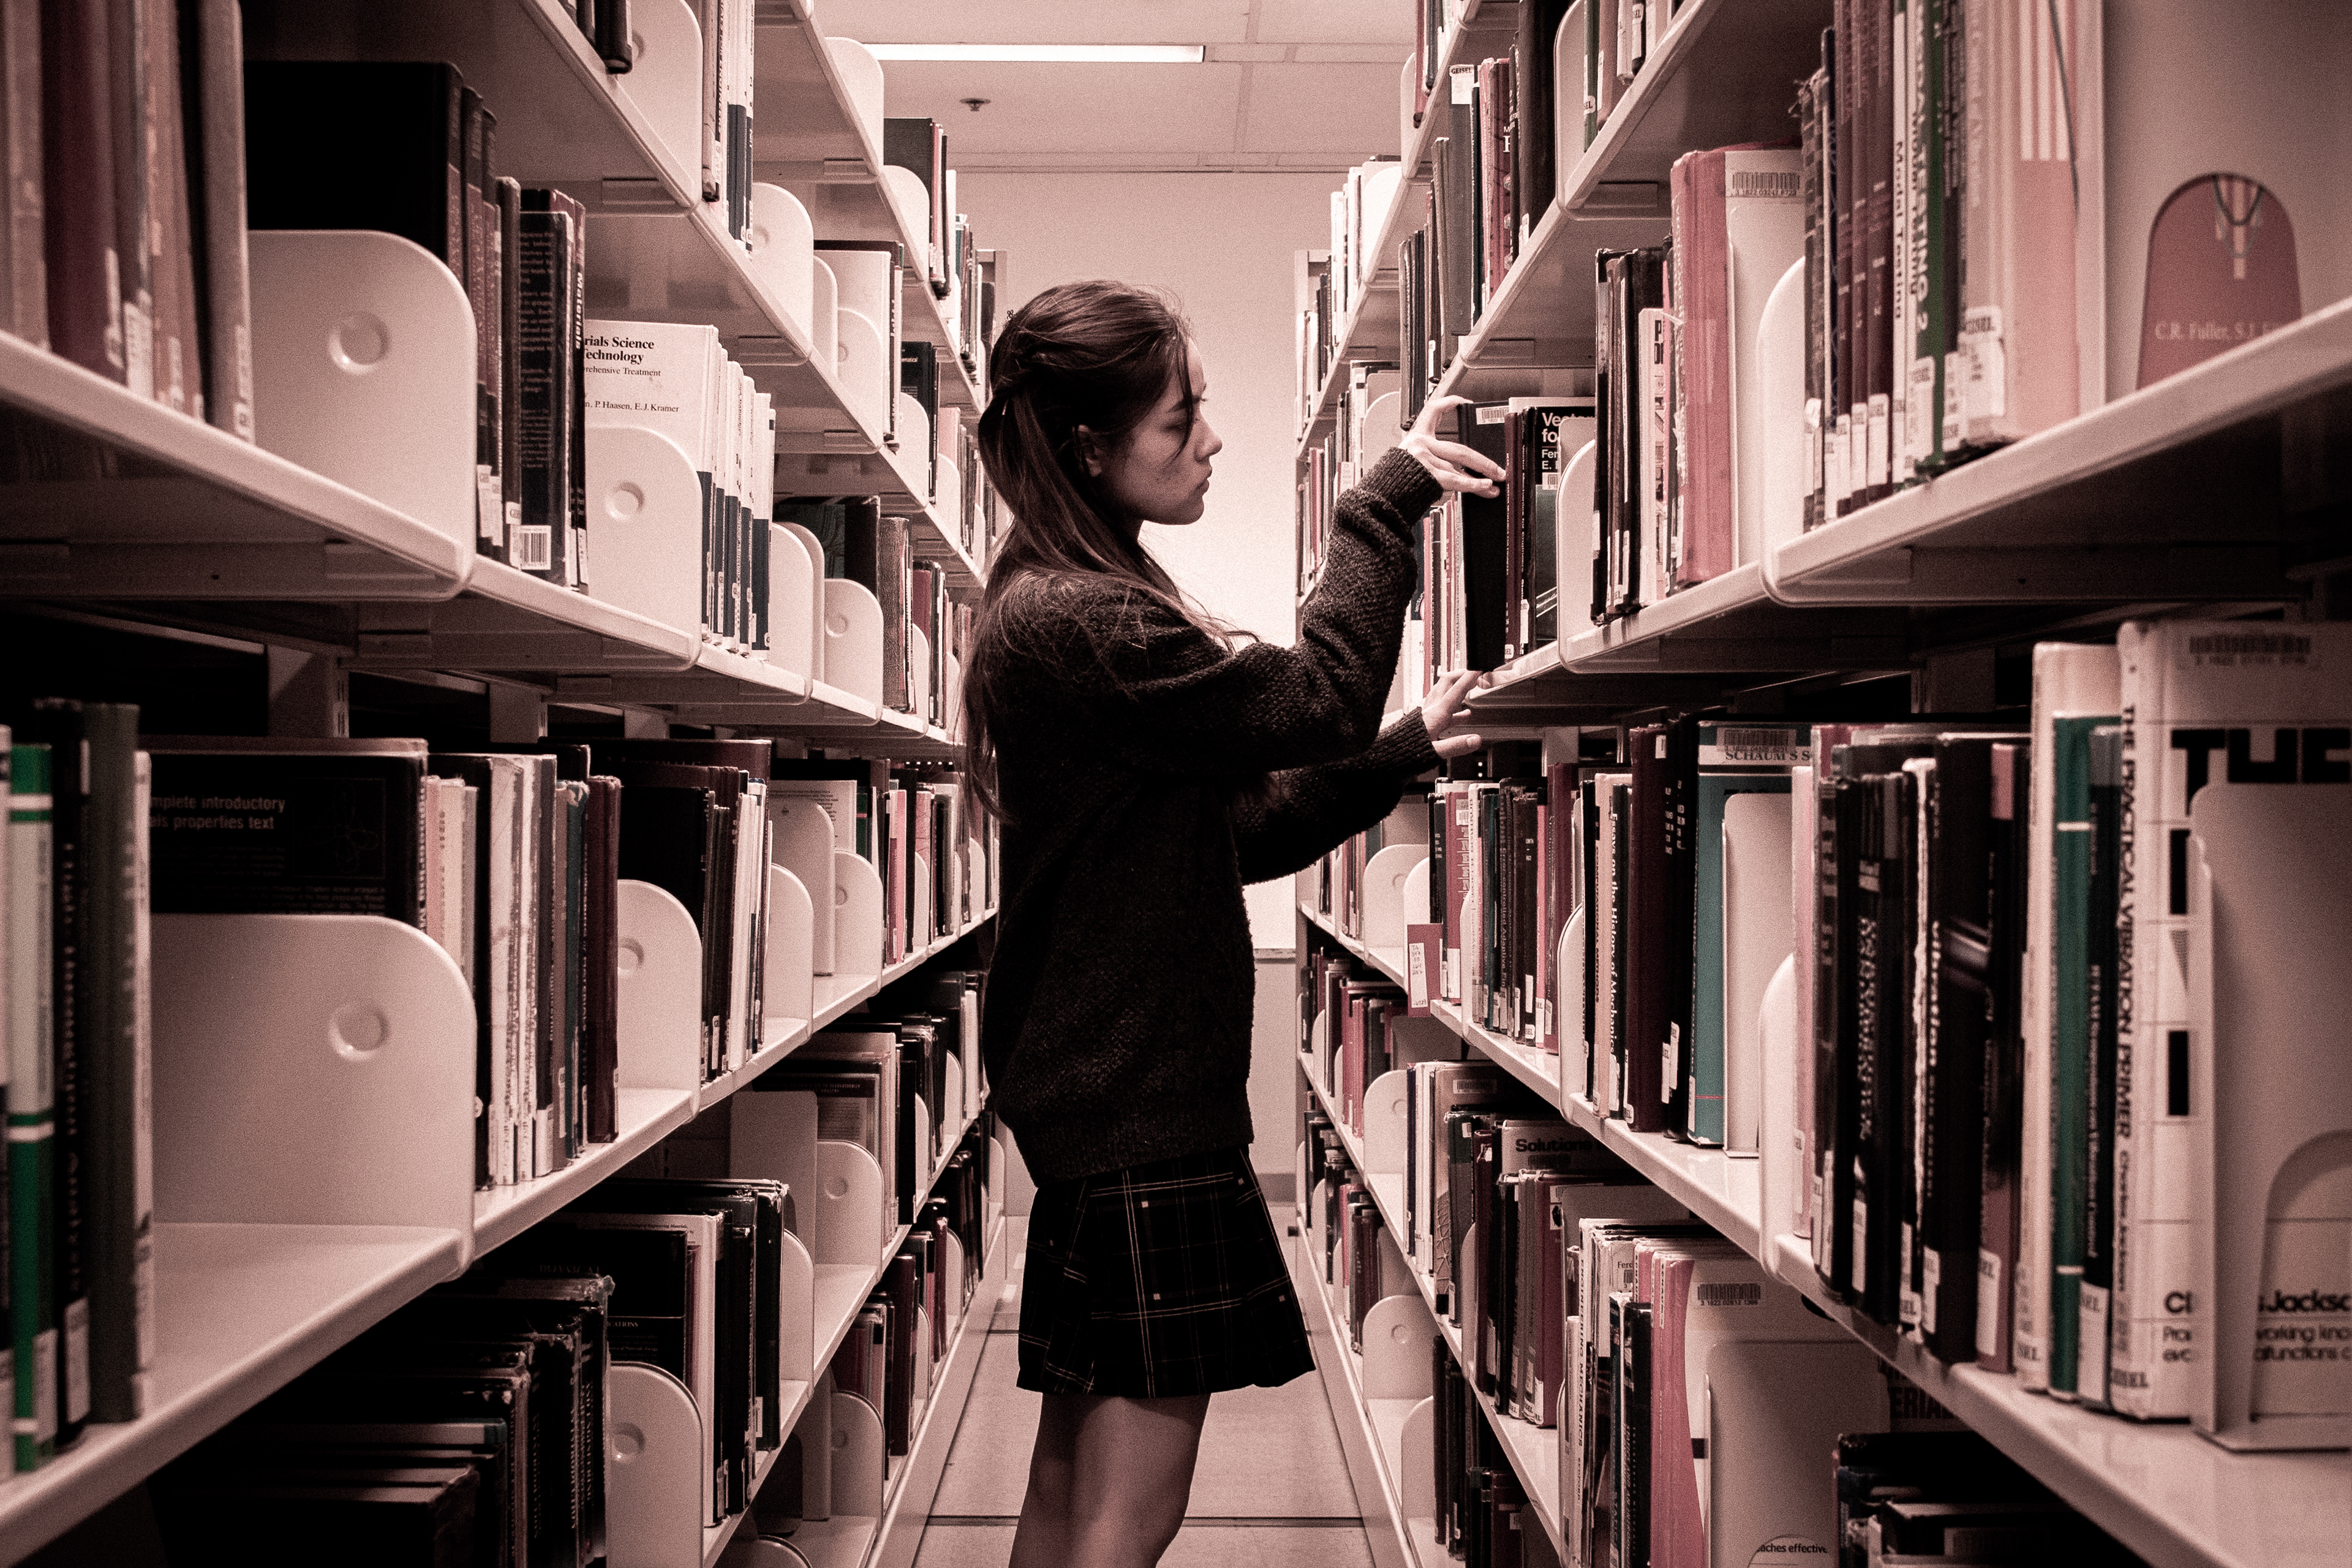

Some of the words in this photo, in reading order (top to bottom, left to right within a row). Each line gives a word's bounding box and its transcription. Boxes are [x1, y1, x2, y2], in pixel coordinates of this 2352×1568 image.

[1895, 227, 1904, 318] Testing
[584, 335, 609, 347] rials
[611, 337, 655, 350] Science
[624, 368, 661, 377] Treatment
[650, 404, 679, 413] Kramer
[1541, 428, 1558, 443] fo
[2122, 705, 2136, 751] THE
[151, 795, 197, 810] mplete
[201, 795, 286, 814] introductory
[173, 815, 244, 831] properties
[248, 815, 274, 830] text
[2120, 760, 2136, 897] PRACTICAL
[1610, 907, 1618, 957] History
[1610, 962, 1618, 978] of
[2117, 905, 2135, 1035] VIBRATION
[1610, 979, 1618, 1054] Mechanics
[2116, 1043, 2132, 1139] PRIMER
[2267, 1289, 2352, 1313] Jackso
